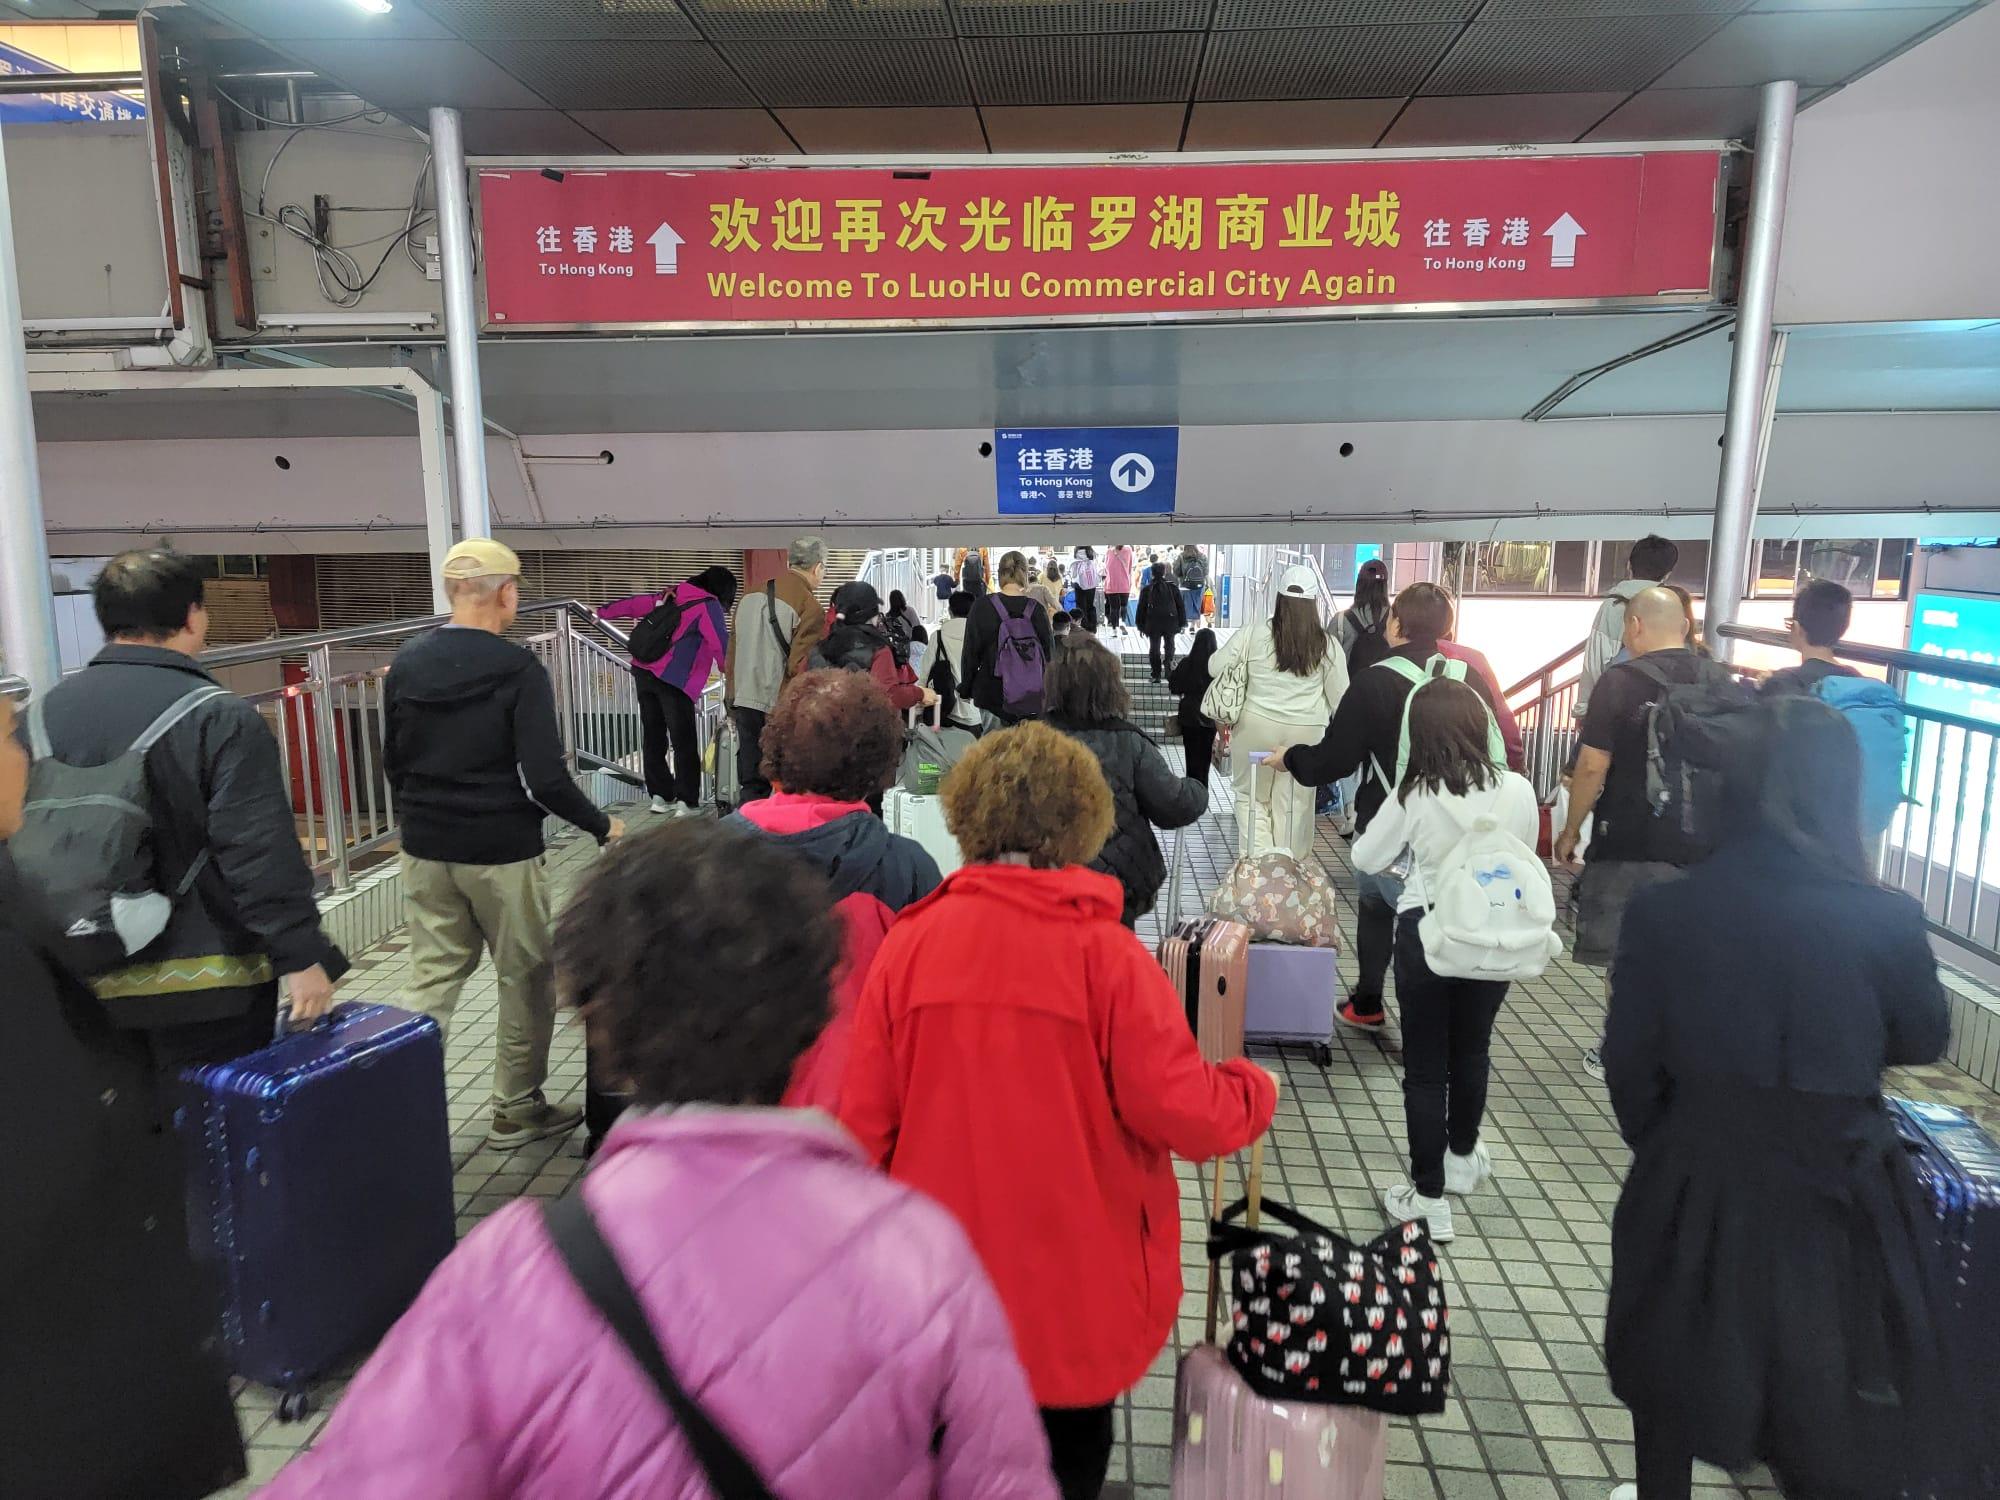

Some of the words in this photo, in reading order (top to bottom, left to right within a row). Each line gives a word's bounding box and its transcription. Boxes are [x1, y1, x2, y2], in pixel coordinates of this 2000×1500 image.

[708, 190, 1401, 253] 欢迎再次光临罗湖商业城
[1422, 216, 1530, 248] 往香港
[535, 225, 634, 254] 往香港
[538, 263, 557, 275] To
[559, 263, 595, 278] Hong
[598, 262, 634, 278] Kong
[1423, 257, 1442, 270] To
[1445, 256, 1484, 272] Hong
[1487, 256, 1526, 272] Kong
[707, 272, 853, 299] Welcome
[860, 272, 900, 299] To
[909, 271, 1011, 299] LuoHu
[1020, 270, 1215, 298] Commercial
[1225, 269, 1290, 302] City
[1299, 268, 1397, 301] Again
[1017, 447, 1094, 471] 往香港
[1019, 477, 1033, 487] To
[1034, 477, 1063, 489] Hong
[1065, 477, 1093, 488] Kong
[1020, 490, 1047, 499] 香港へ
